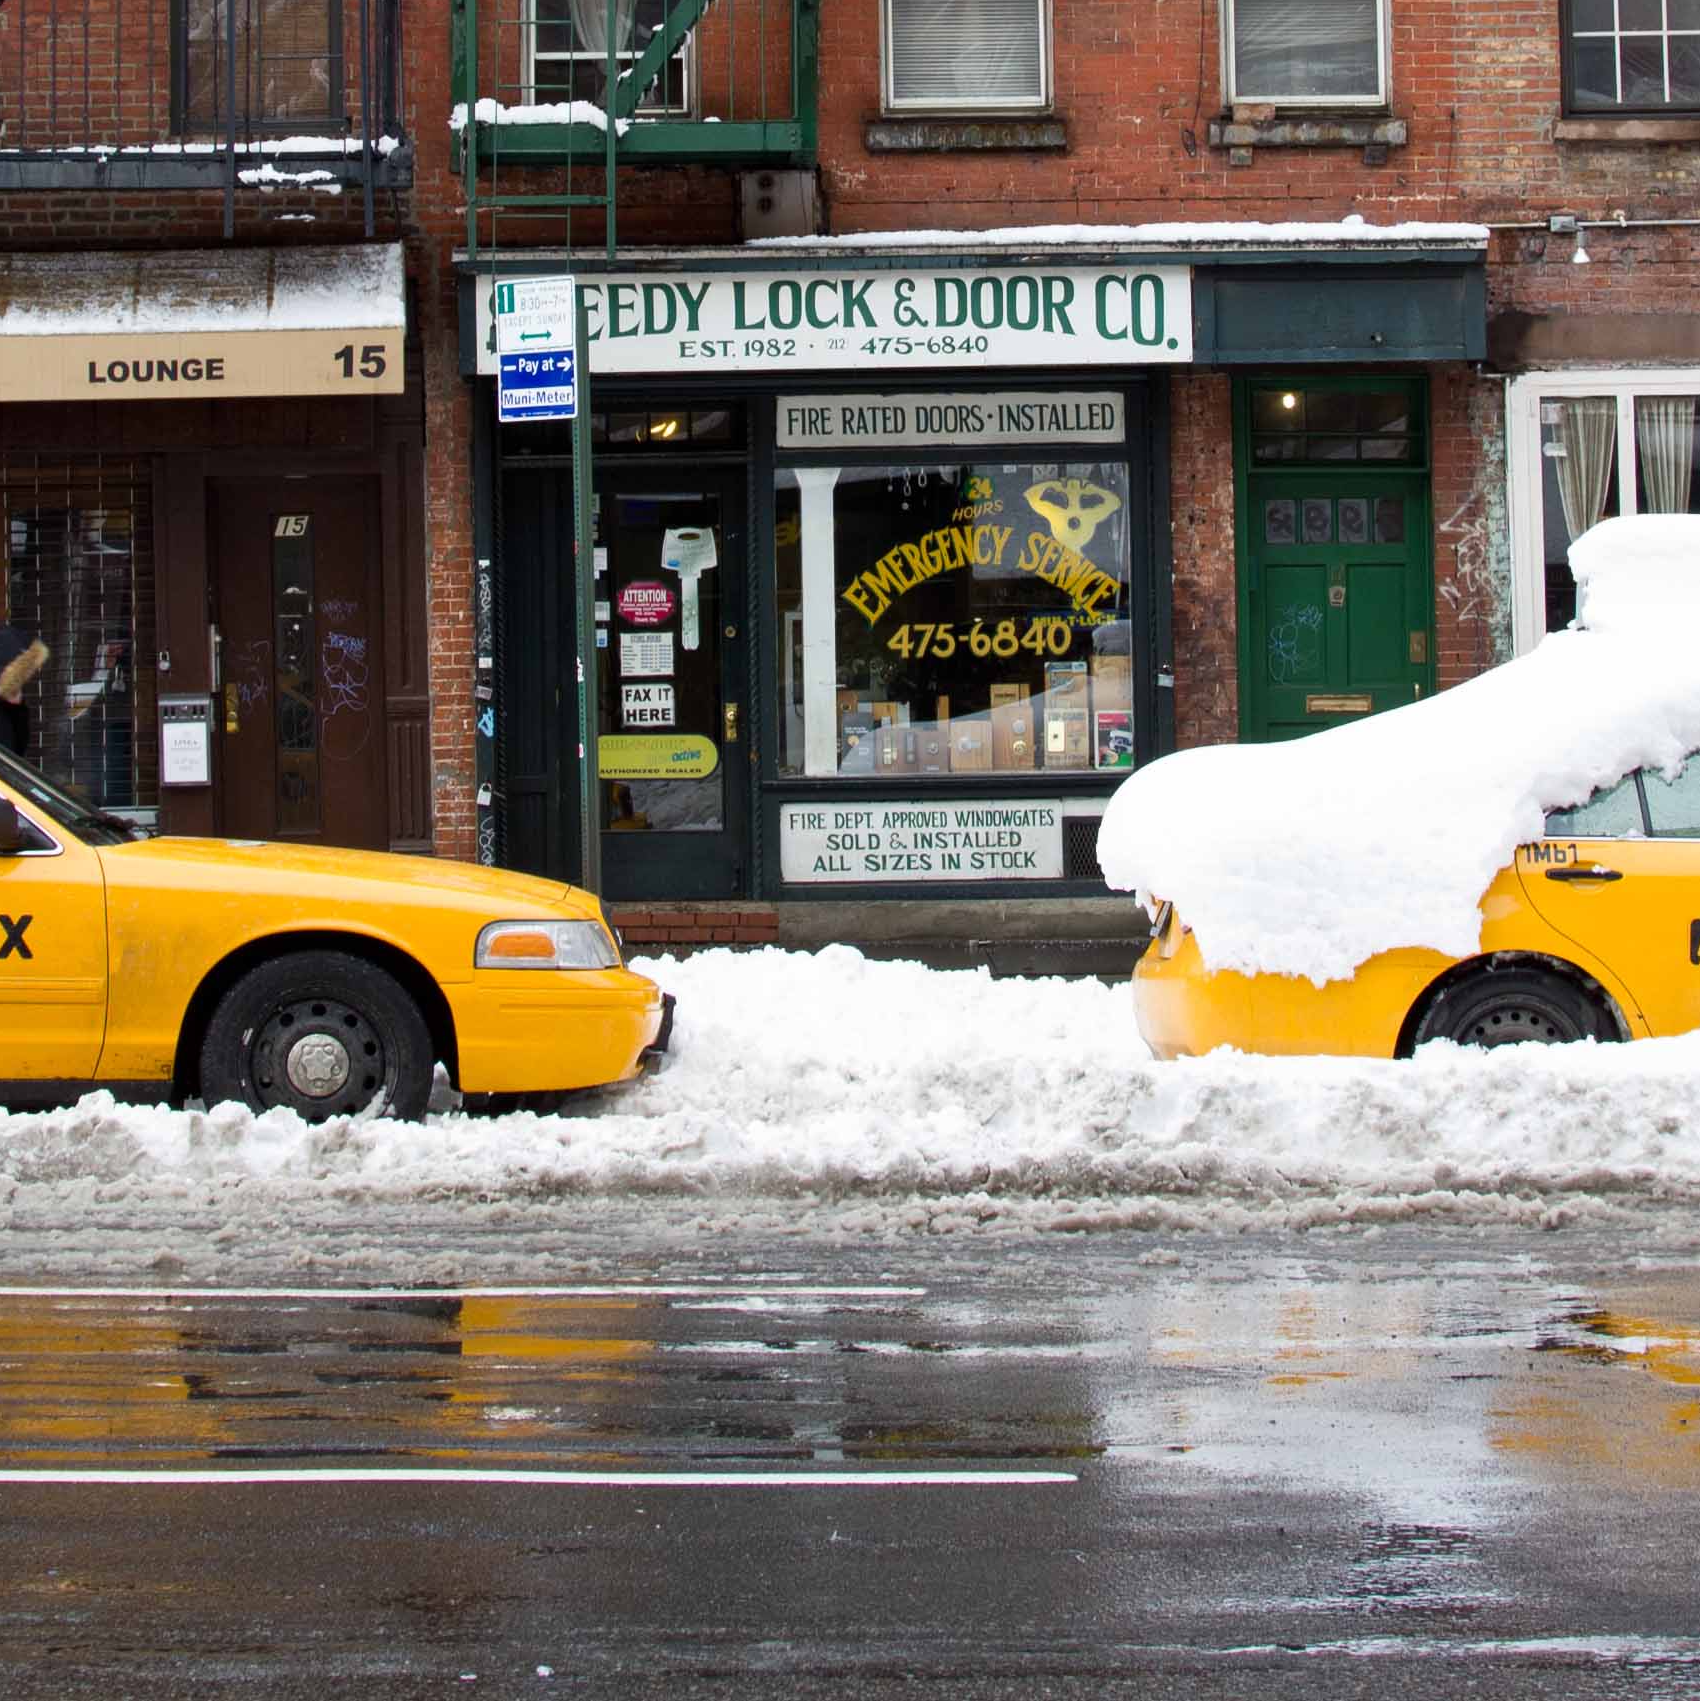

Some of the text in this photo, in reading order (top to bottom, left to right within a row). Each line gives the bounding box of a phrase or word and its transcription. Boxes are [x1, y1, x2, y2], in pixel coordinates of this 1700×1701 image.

[486, 273, 1179, 355] EEDY LOCK & DOOR CO.
[679, 335, 989, 358] EST. 1982 212 475-6840
[88, 358, 225, 383] LOUNGE
[334, 344, 387, 379] 15
[518, 357, 555, 376] Pay at
[503, 391, 572, 406] Muni-Meter
[786, 403, 1115, 436] FIRE RATED DOORS INSTALLED
[968, 476, 993, 500] 24
[952, 500, 1004, 522] HOURS
[283, 518, 306, 534] 15
[841, 523, 1122, 626] EMERGENCY SERVICE
[624, 589, 667, 603] ATTENTION
[887, 619, 1072, 659] 475-6840
[625, 688, 672, 702] FAX IT
[626, 707, 672, 723] HERE
[789, 809, 1055, 830] FIRE DEPT. APPROVED WINDOWGATES
[826, 831, 1022, 851] SOLD & INSTALLED
[812, 851, 1037, 872] ALL SIZES IN STOCK
